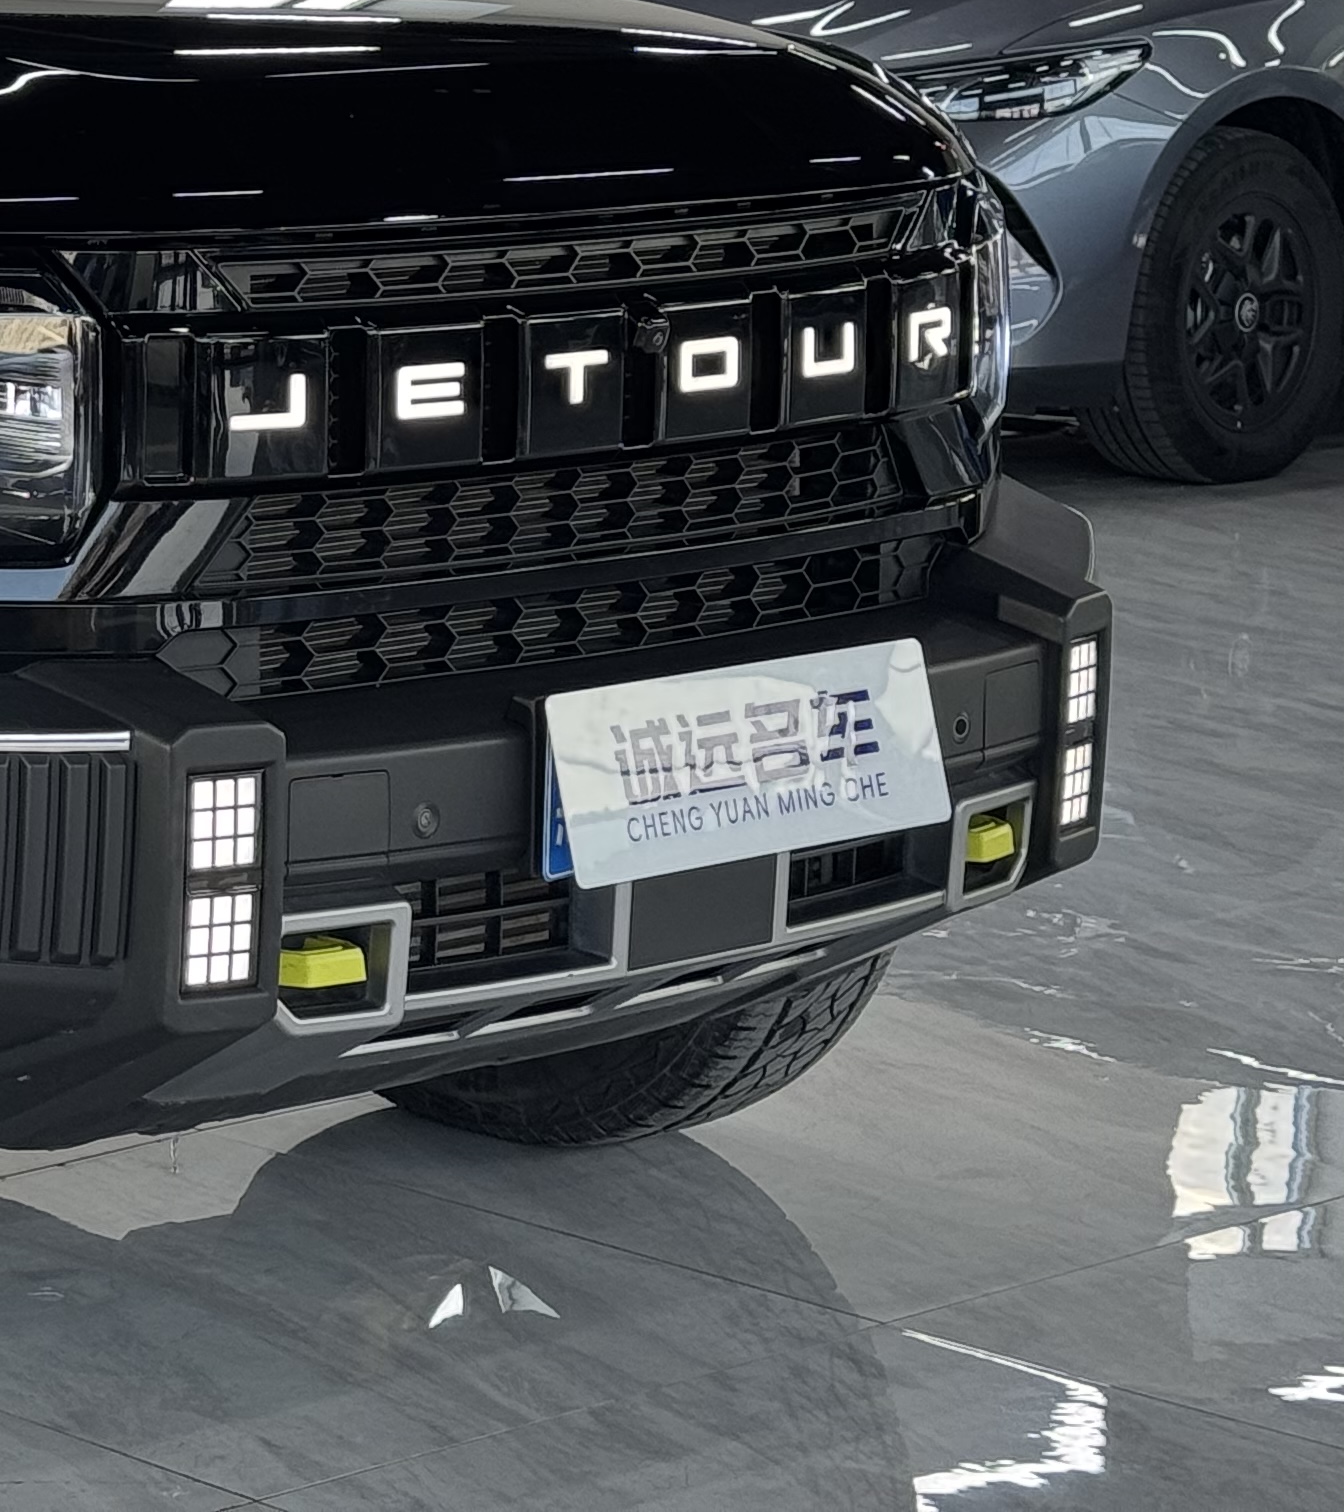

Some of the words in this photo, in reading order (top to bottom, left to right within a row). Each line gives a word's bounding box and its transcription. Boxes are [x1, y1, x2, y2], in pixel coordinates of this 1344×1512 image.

[229, 306, 952, 431] JETOUR
[610, 688, 881, 806] 诚远名车
[626, 805, 704, 843] CHENG
[709, 792, 771, 829] YUAN
[777, 781, 836, 816] MING
[844, 771, 890, 803] CHE
